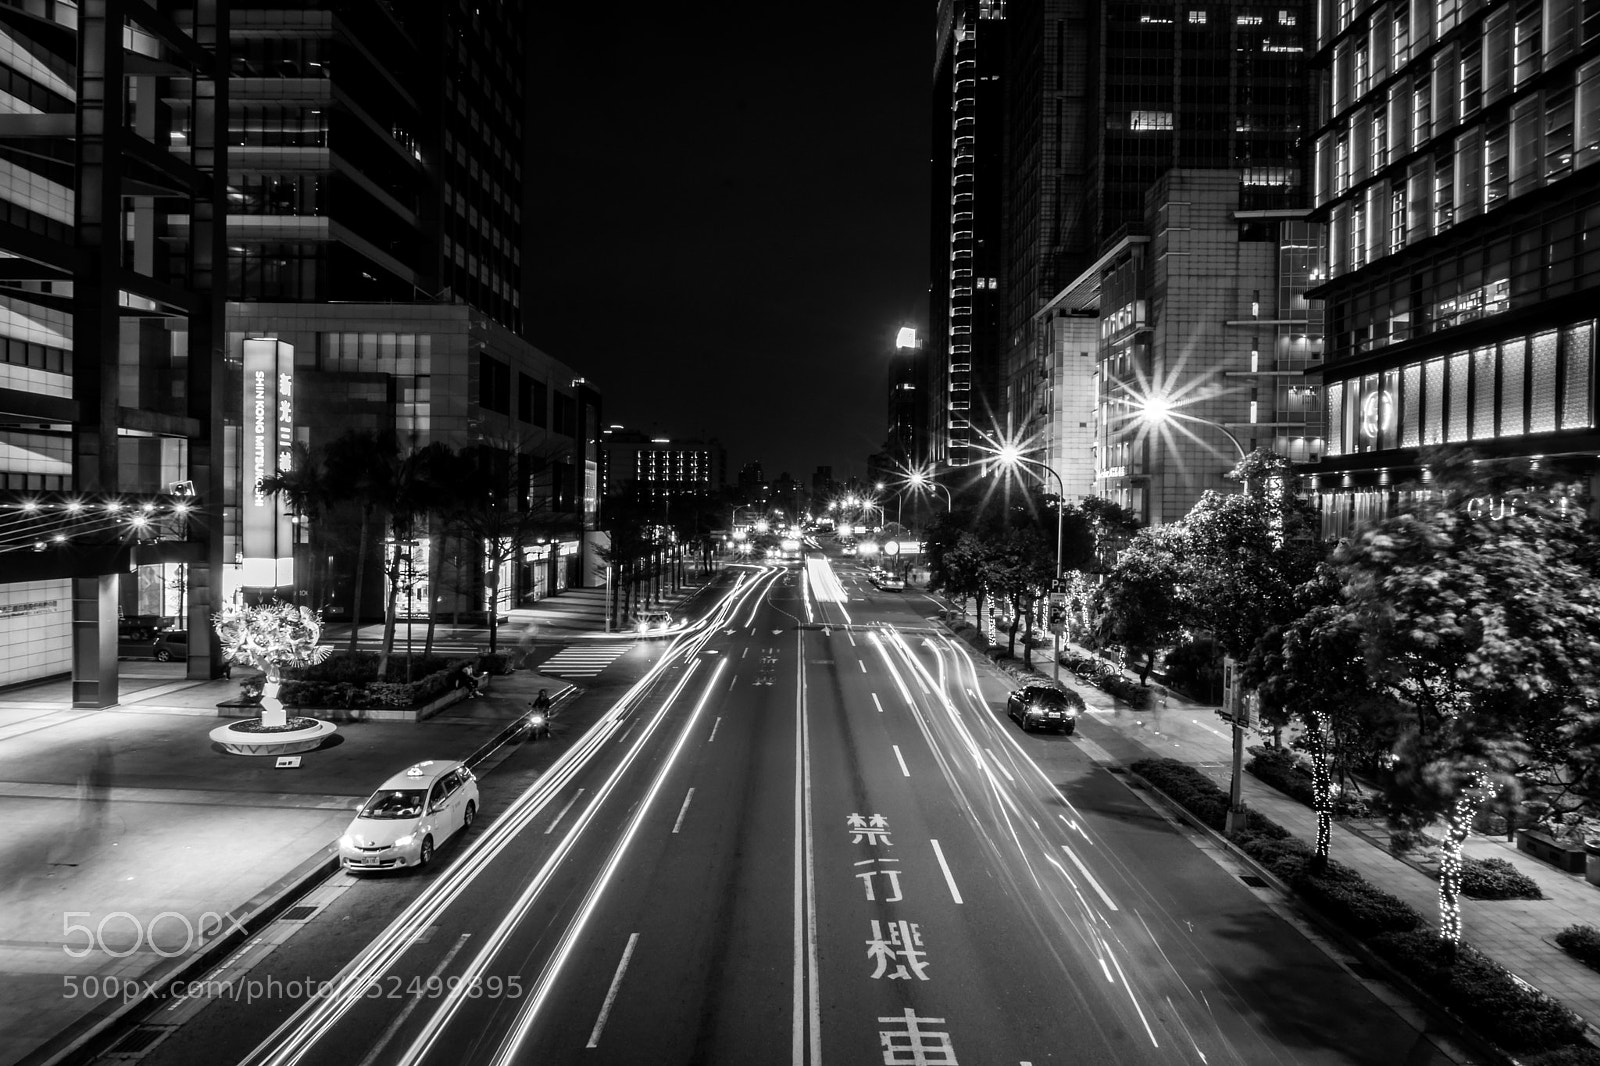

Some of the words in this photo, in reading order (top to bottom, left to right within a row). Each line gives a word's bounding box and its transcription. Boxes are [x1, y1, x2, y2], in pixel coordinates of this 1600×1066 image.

[254, 371, 265, 399] SHIN
[254, 400, 265, 434] KONG
[254, 435, 265, 507] MITSUKOSHI
[1467, 496, 1568, 521] GUCI
